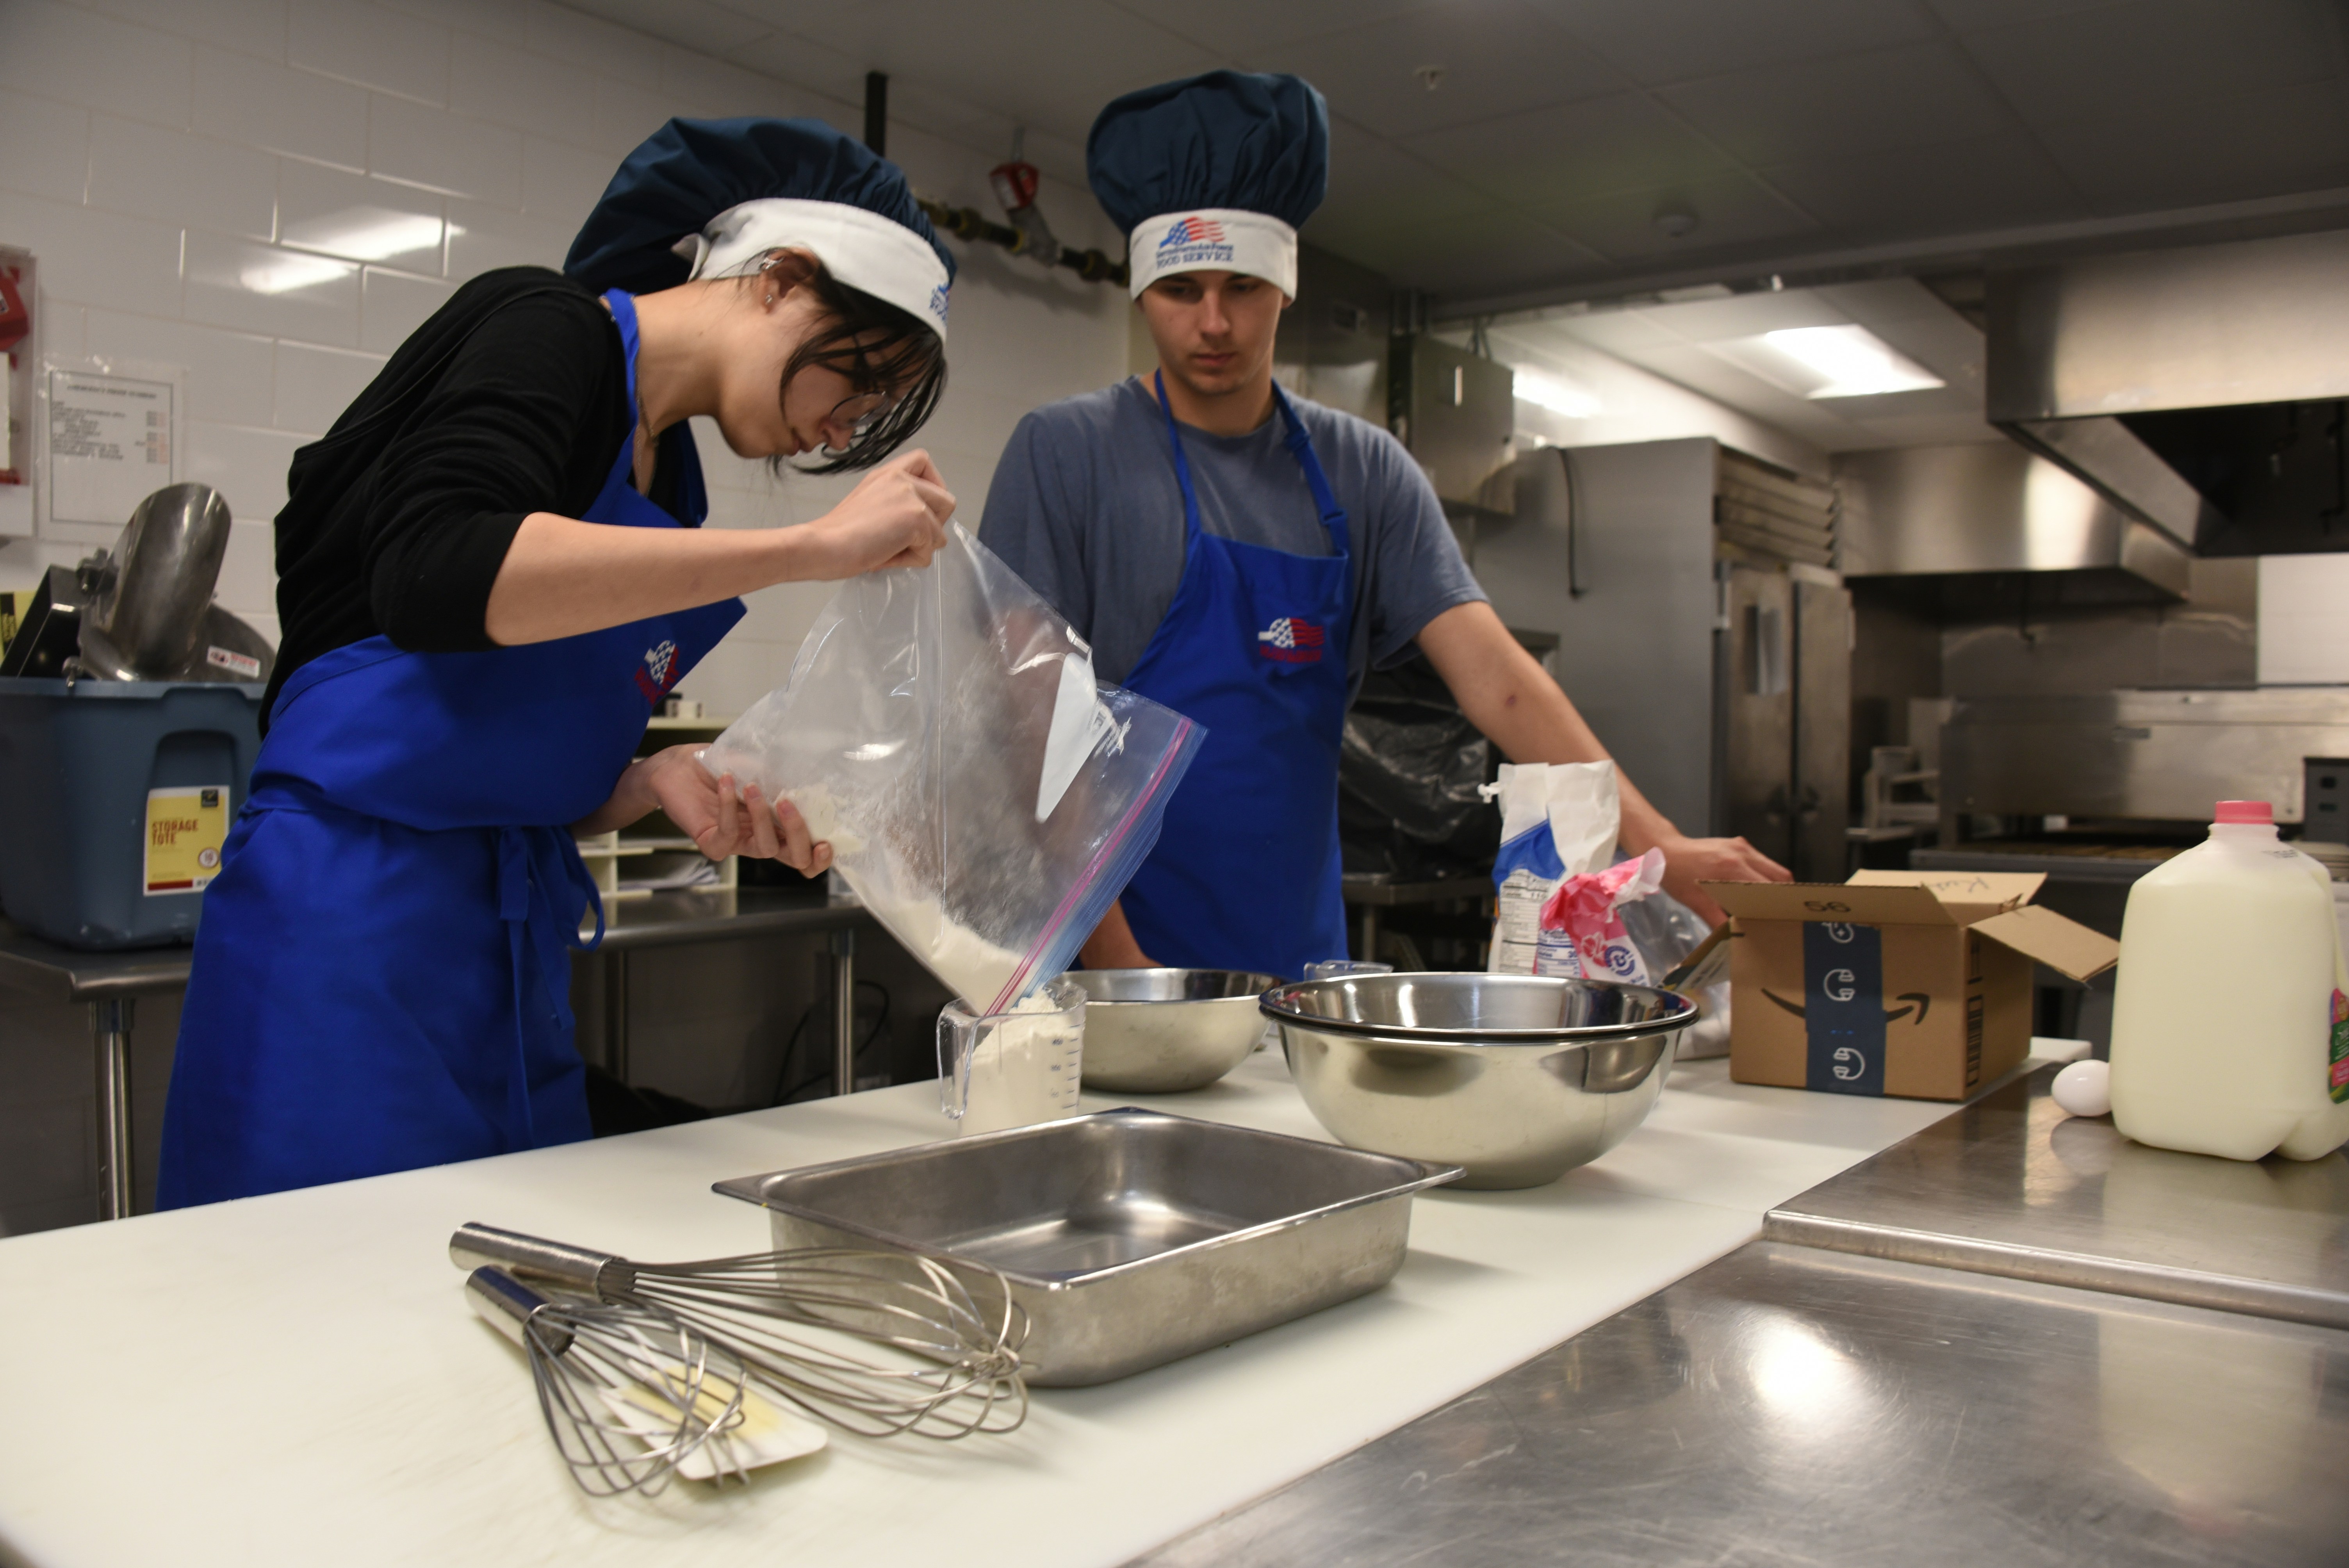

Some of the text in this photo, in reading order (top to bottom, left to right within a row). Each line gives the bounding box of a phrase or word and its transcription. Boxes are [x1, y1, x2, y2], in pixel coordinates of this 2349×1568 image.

[1157, 255, 1181, 270] FOOD
[1183, 252, 1234, 263] SERVICE
[152, 819, 199, 832] STORAGE
[152, 830, 176, 846] TOTE
